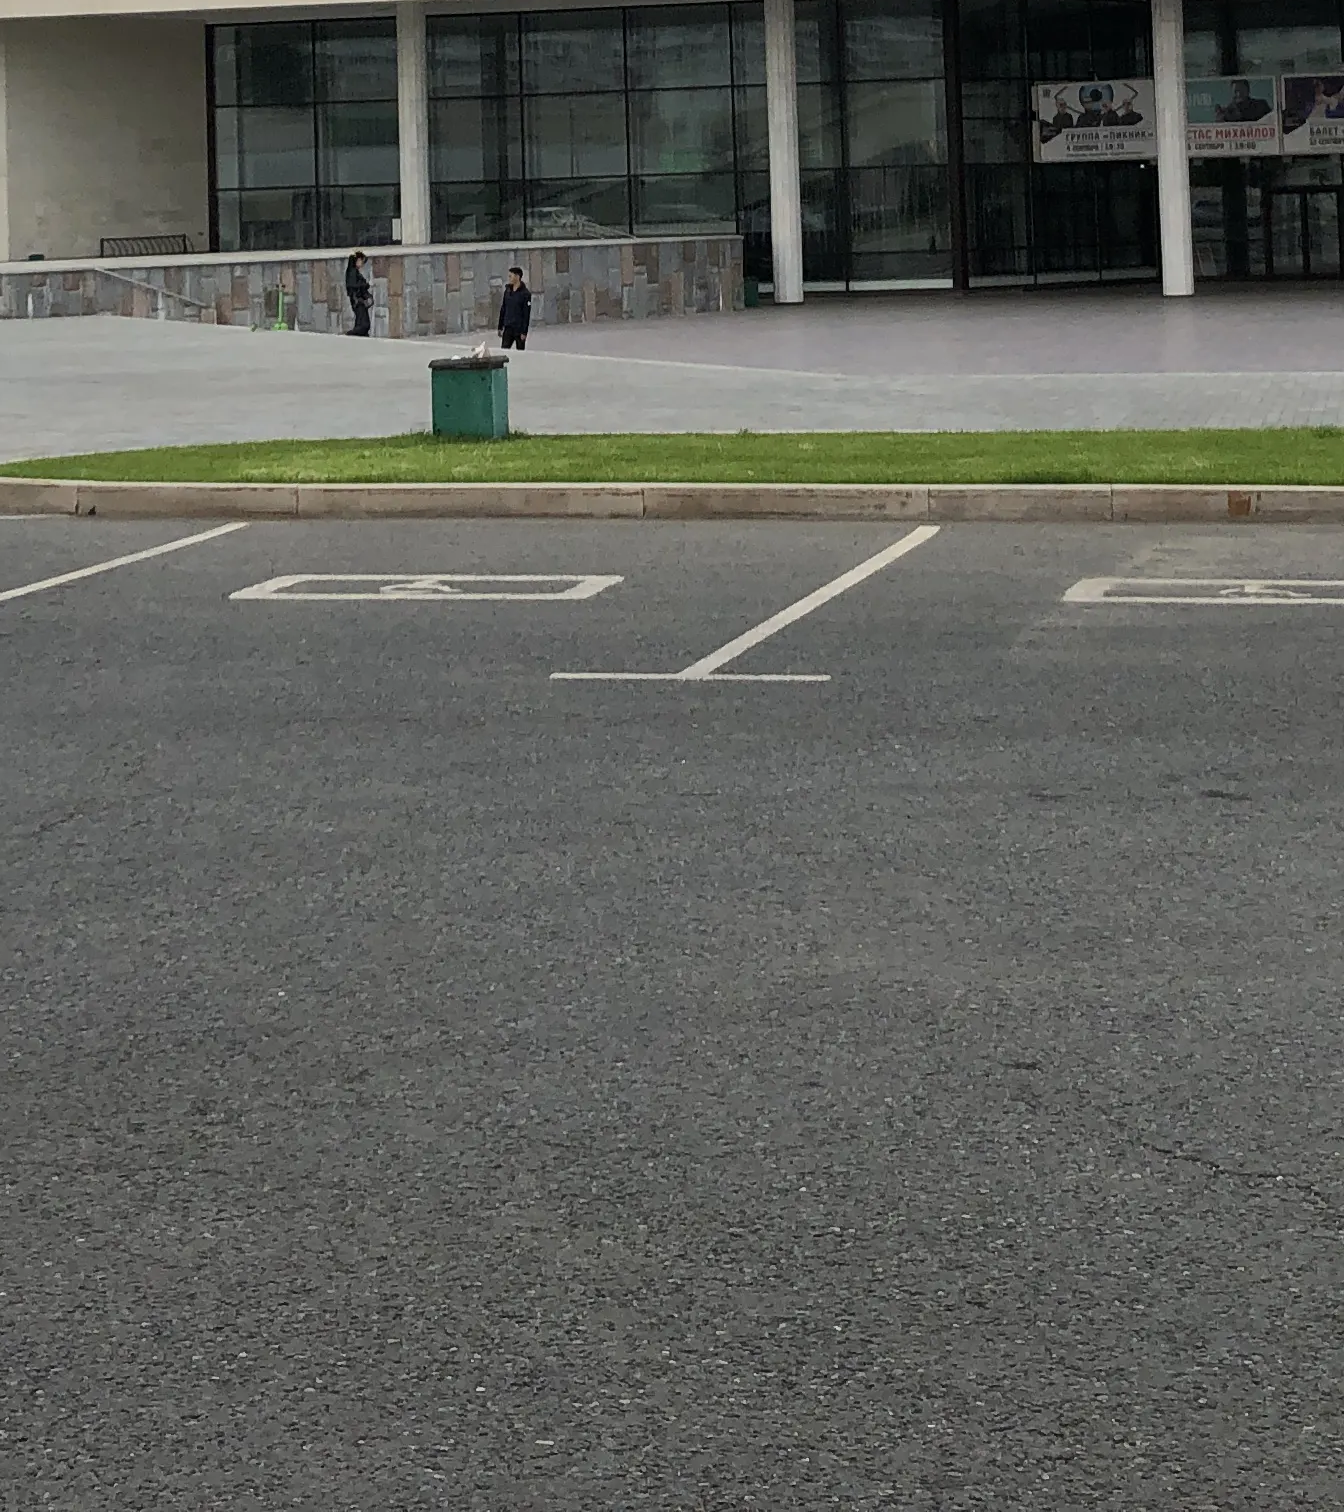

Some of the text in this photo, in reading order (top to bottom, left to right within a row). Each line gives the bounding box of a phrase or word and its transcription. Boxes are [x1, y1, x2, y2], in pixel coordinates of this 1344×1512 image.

[1065, 131, 1100, 142] ГРУППА
[1215, 126, 1276, 140] МИХАЙЛОВ
[1309, 126, 1337, 136] БАЛЕТ
